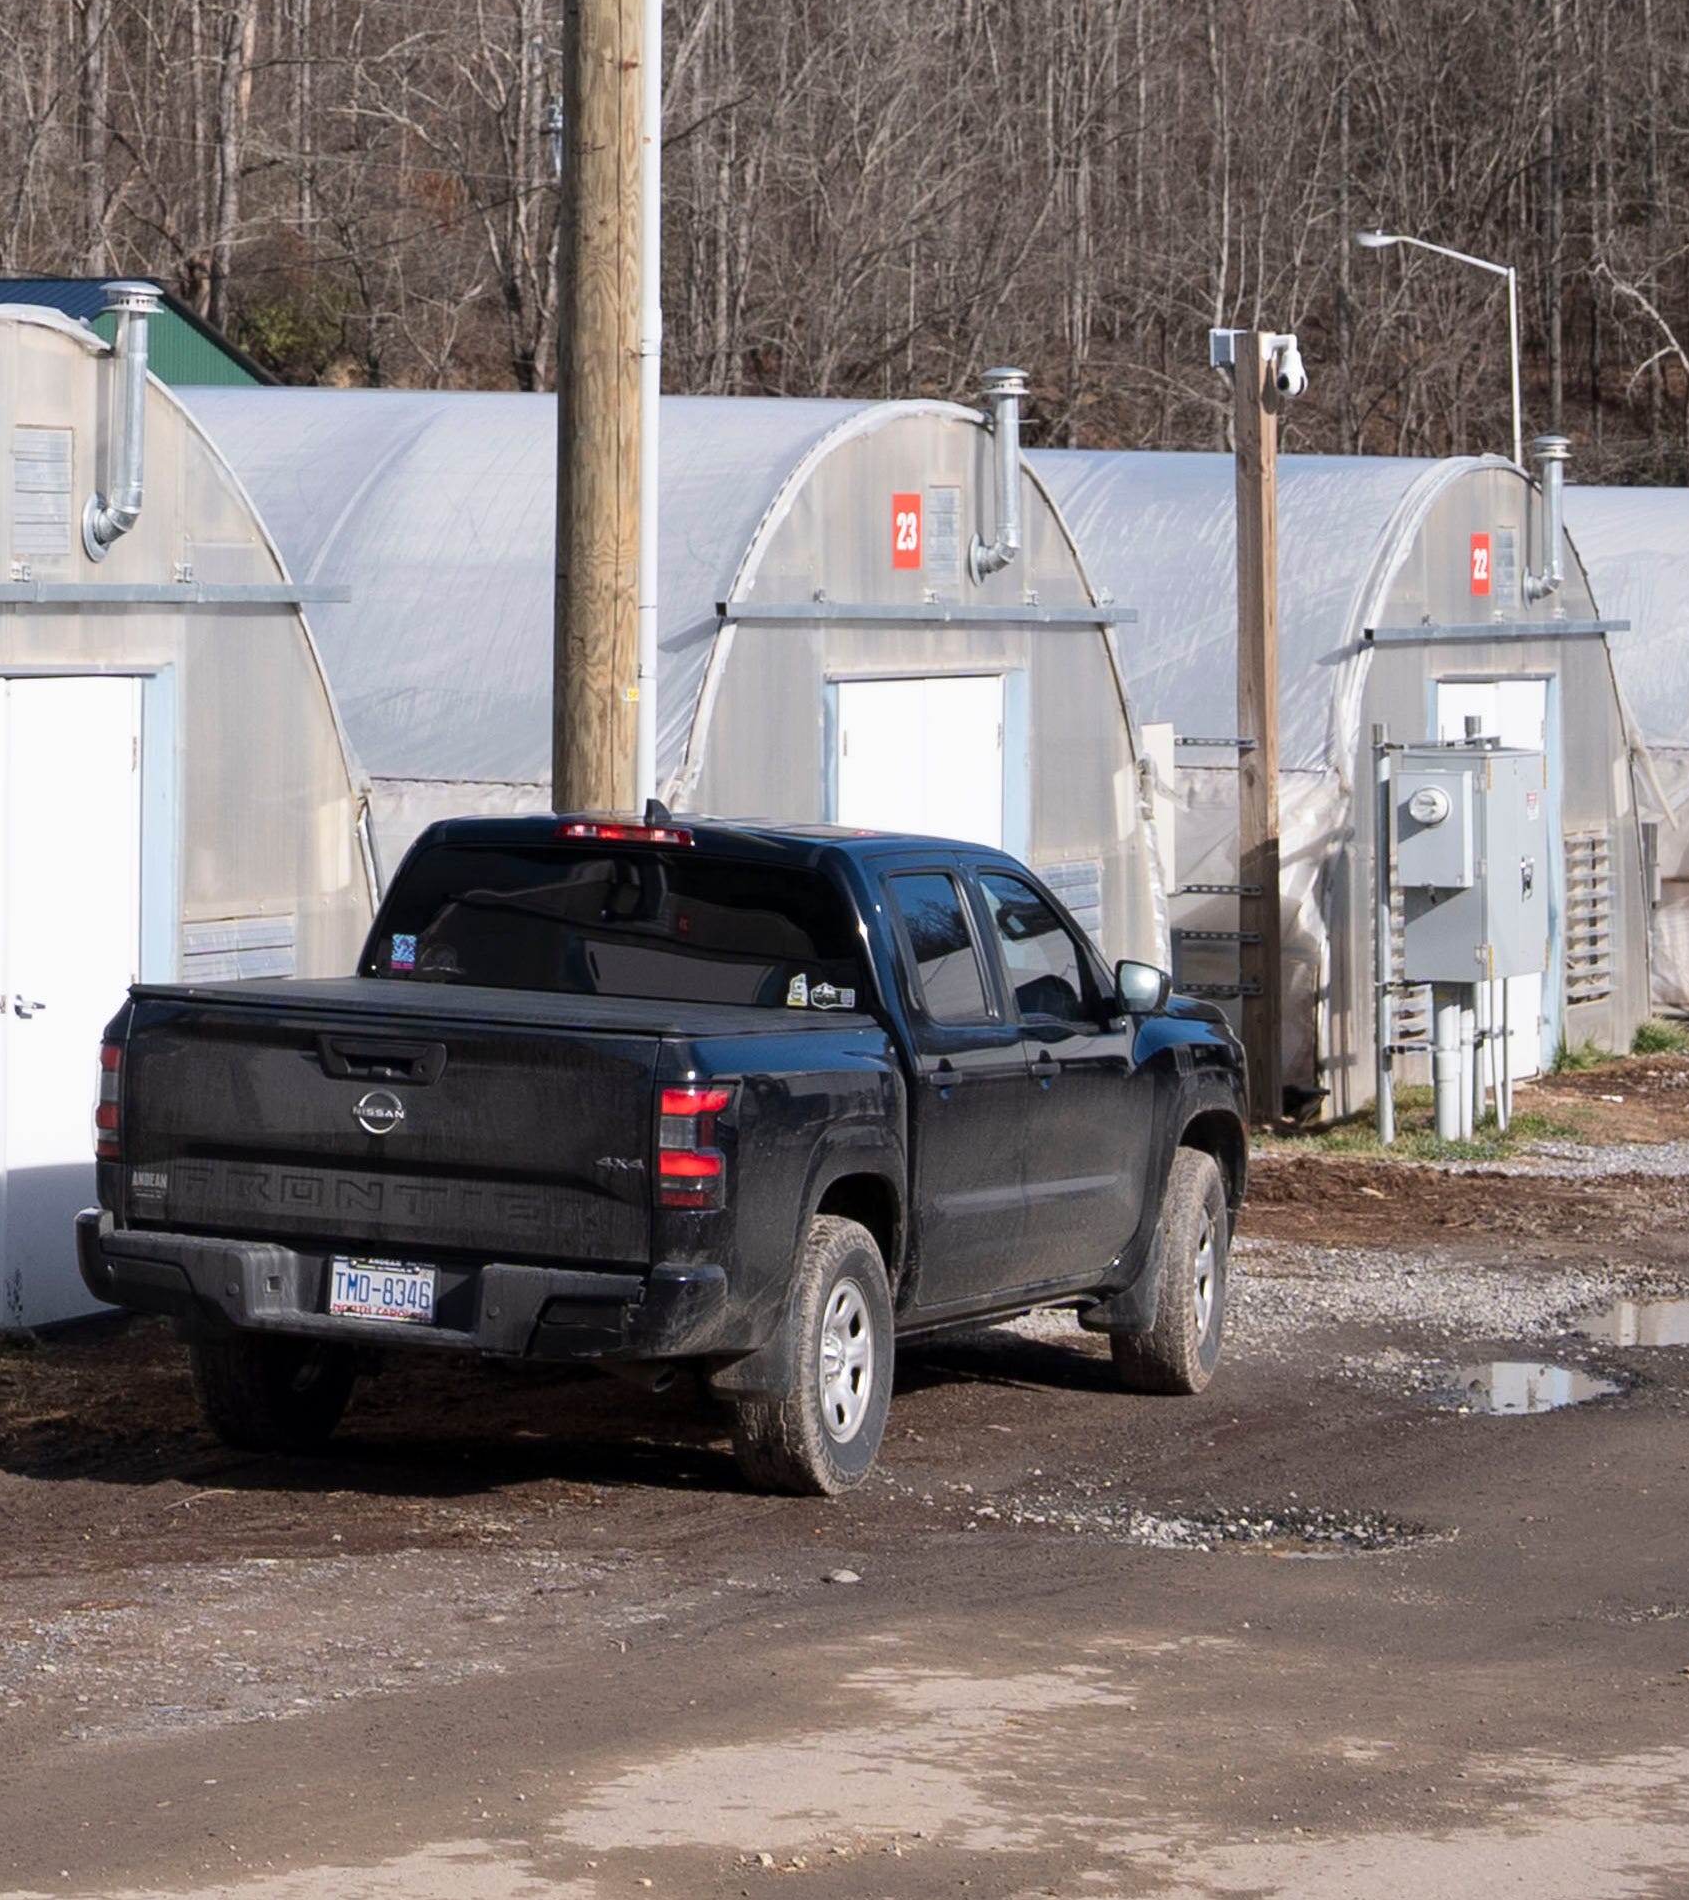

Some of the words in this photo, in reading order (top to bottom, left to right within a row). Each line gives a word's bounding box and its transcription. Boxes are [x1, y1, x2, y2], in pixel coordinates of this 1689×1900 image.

[896, 511, 918, 551] 23
[1473, 548, 1488, 580] 22
[352, 1105, 405, 1119] NISSAN
[335, 1271, 431, 1310] TMD-8346
